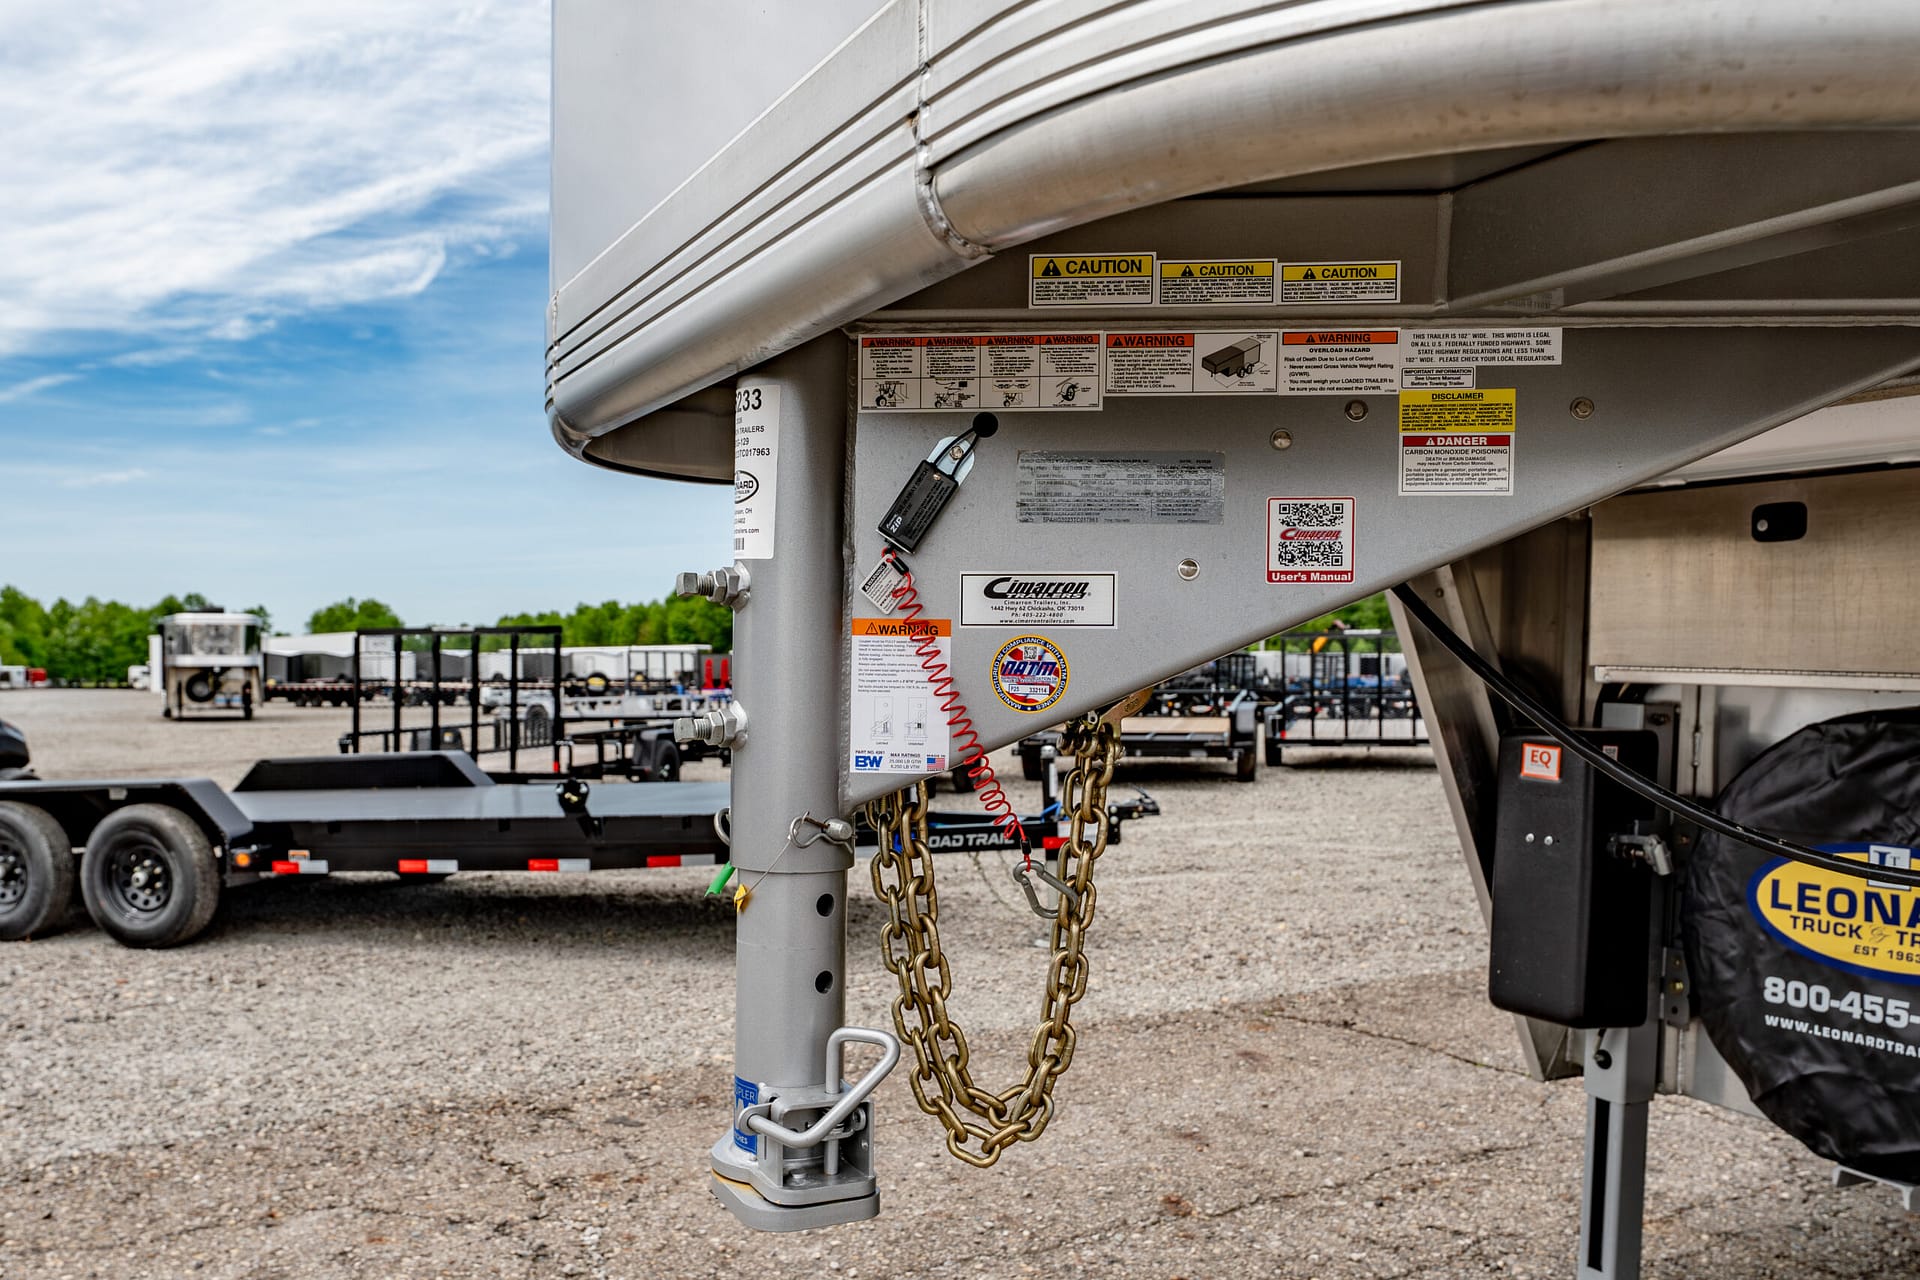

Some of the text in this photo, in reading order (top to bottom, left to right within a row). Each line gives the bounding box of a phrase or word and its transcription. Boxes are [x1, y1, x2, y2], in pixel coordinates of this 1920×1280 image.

[1066, 260, 1142, 274] CAUTION
[1200, 266, 1254, 276] CAUTION
[1322, 268, 1376, 278] CAUTION
[1124, 336, 1185, 346] WARNING
[1318, 334, 1371, 342] WARNING
[736, 388, 762, 412] 233
[1437, 437, 1488, 445] DANGER
[1272, 572, 1351, 581] User's Manual
[984, 577, 1090, 599] Cimarron
[878, 625, 938, 635] WARNING
[1002, 638, 1045, 653] COMPLIANCE
[1046, 643, 1061, 658] WITH
[1001, 661, 1058, 676] NATM
[1530, 749, 1552, 769] EQ
[928, 835, 964, 848] OAD
[1790, 915, 1863, 940] TRUCK
[1854, 944, 1920, 964] EST 1963
